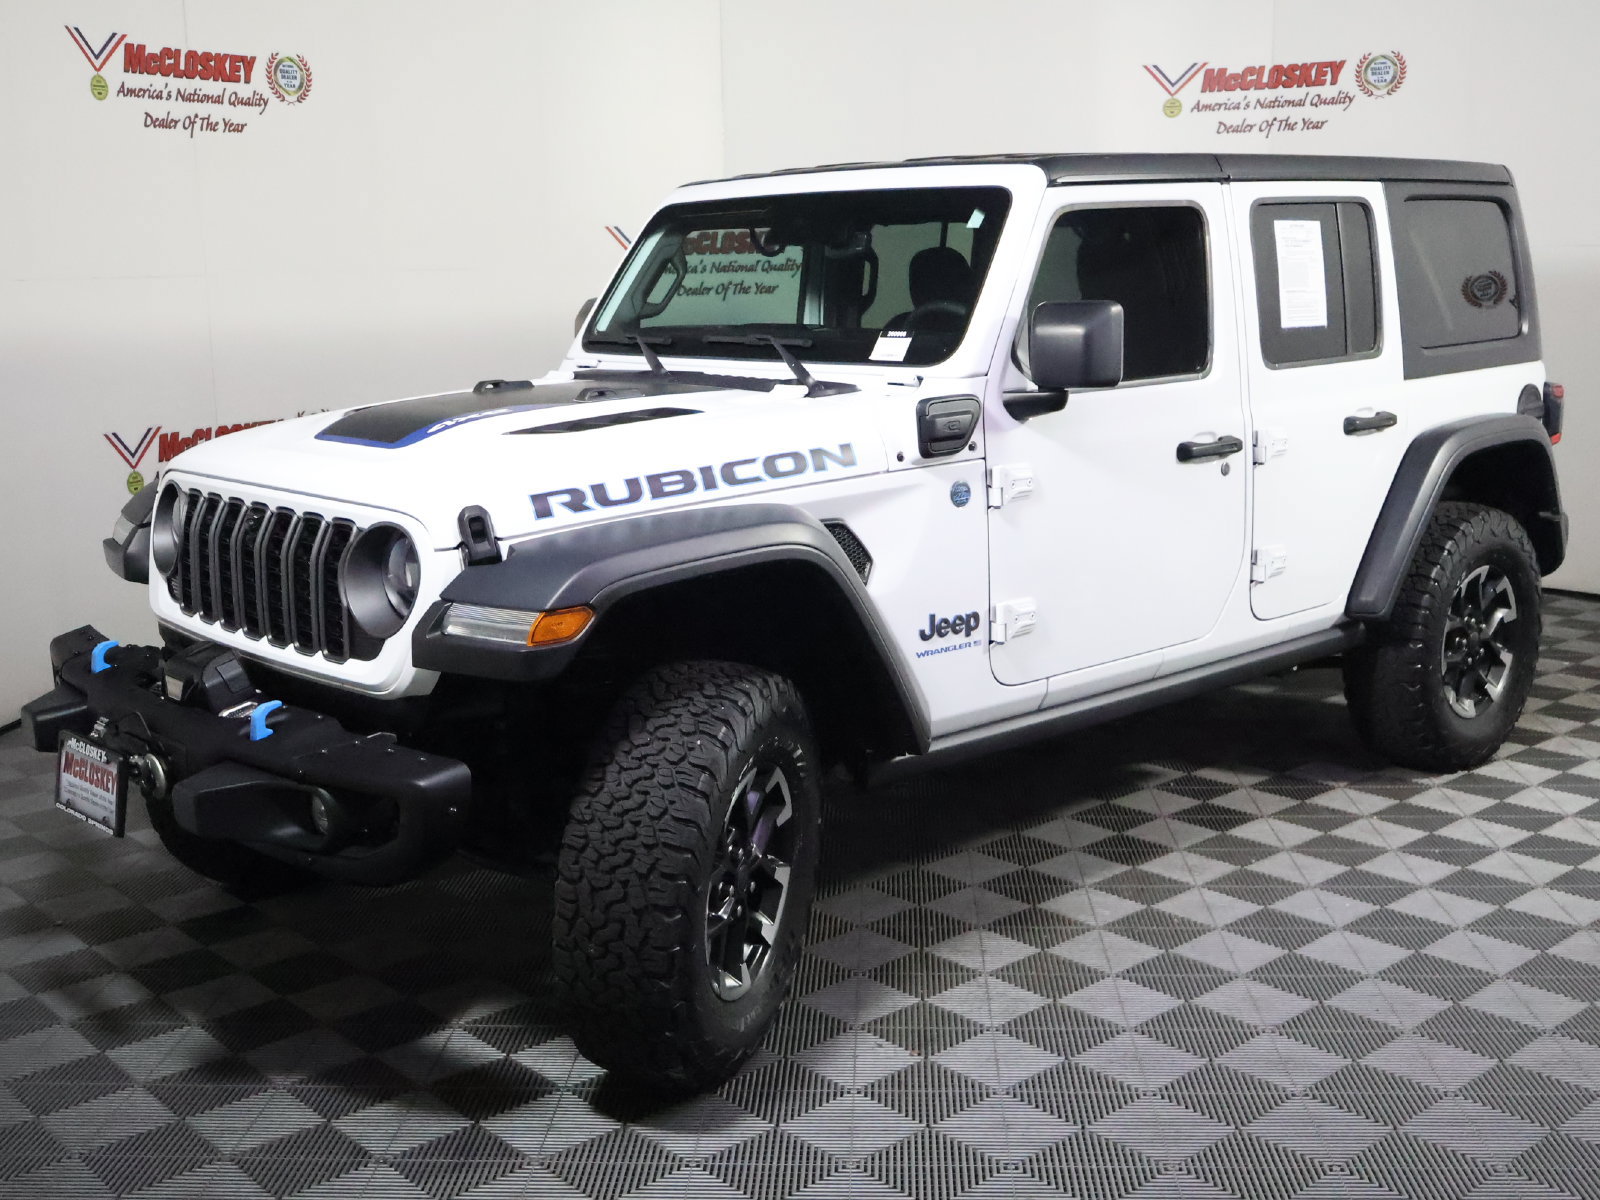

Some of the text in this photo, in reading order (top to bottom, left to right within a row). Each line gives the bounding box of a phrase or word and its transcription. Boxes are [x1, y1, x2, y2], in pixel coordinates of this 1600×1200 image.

[123, 42, 256, 84] McCLOSKEY
[1200, 59, 1347, 94] McCLOSKEY
[116, 81, 172, 101] America's
[175, 87, 227, 105] National
[228, 93, 269, 115] Quality
[1190, 95, 1250, 113] America's
[1253, 93, 1306, 110] National
[1309, 89, 1356, 112] Quality
[143, 111, 248, 138] Dealer Of The Year
[1215, 116, 1329, 138] Dealer Of The Year
[710, 259, 759, 275] National
[761, 257, 802, 278] Quality
[676, 280, 779, 301] Dealer Of The Year
[528, 441, 858, 521] RUBICON
[918, 610, 980, 641] Jeep
[915, 641, 972, 659] WRANGLER
[70, 737, 106, 763] McCLOSKEY
[63, 751, 118, 796] McCLOSKEY
